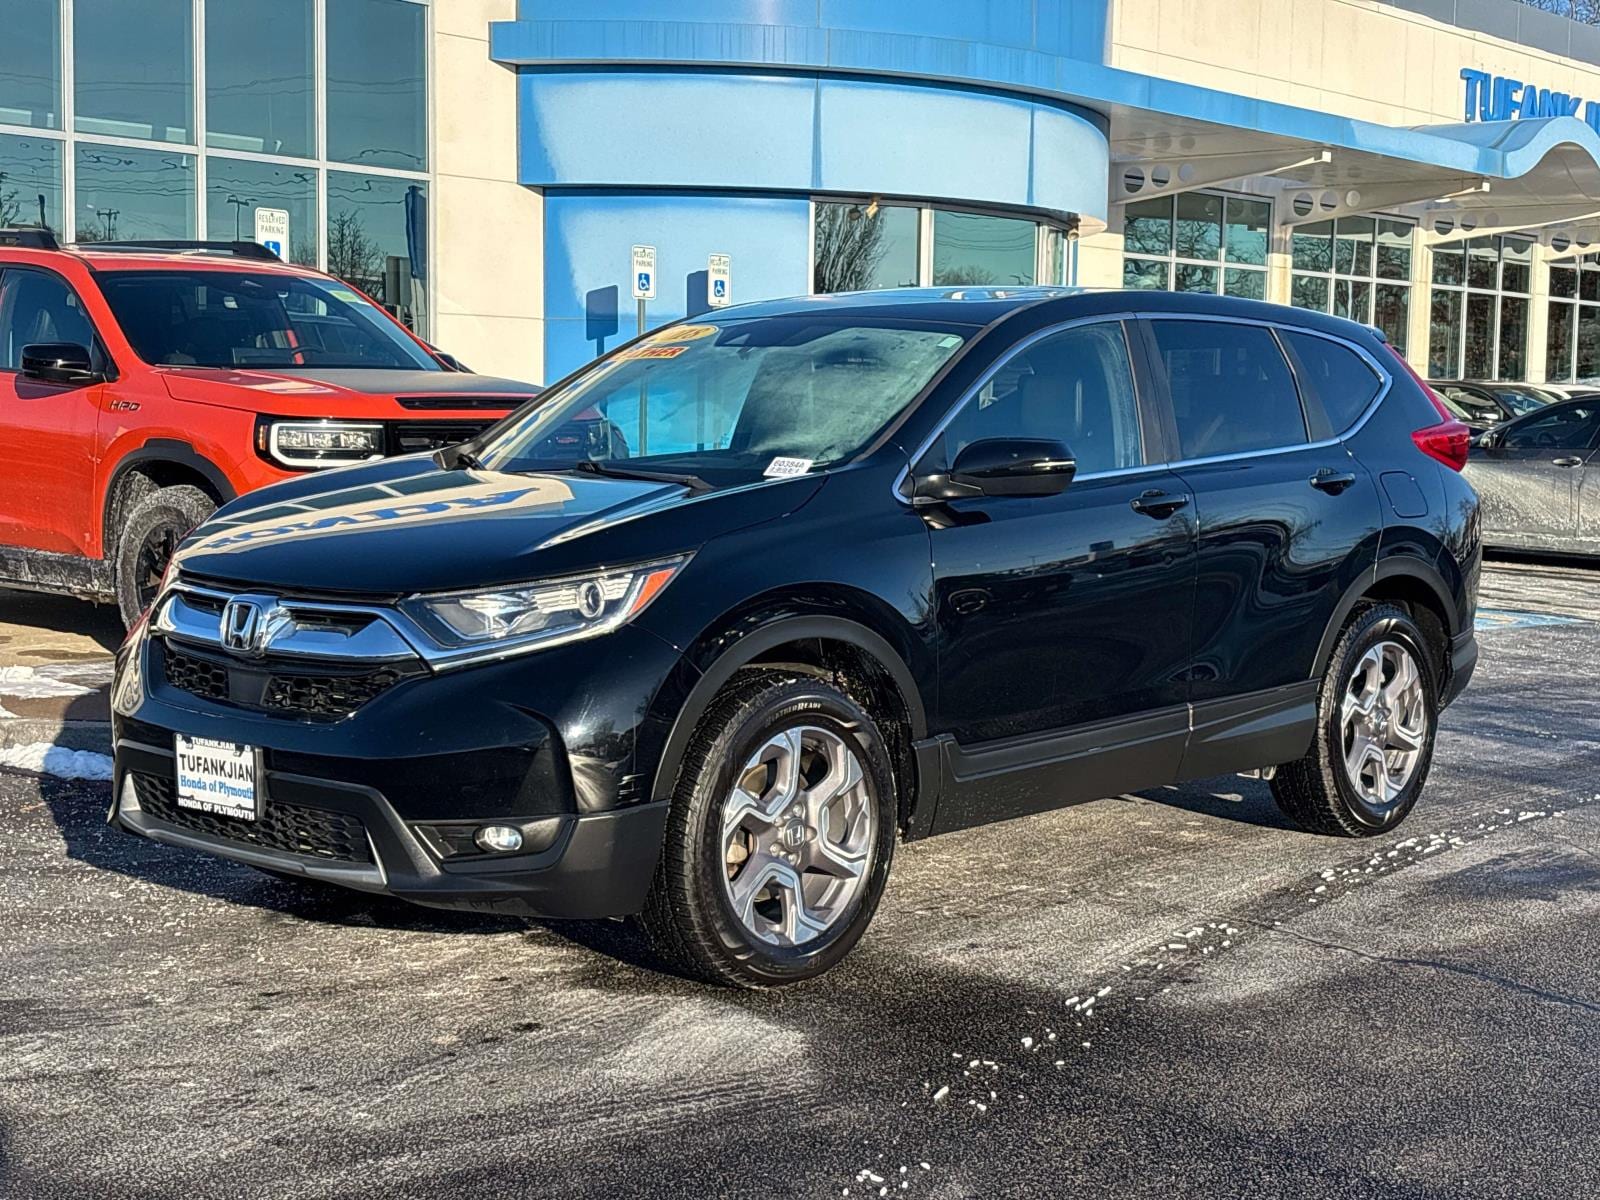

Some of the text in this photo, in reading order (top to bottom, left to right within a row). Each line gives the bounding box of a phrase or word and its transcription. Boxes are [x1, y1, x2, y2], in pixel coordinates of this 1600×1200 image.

[261, 225, 284, 234] PARKING
[109, 399, 141, 411] HPD
[179, 753, 253, 782] TUFANKJIAN
[180, 774, 254, 800] Honda of Plymouth
[178, 798, 254, 820] HONDA OF PLYMOUTH
